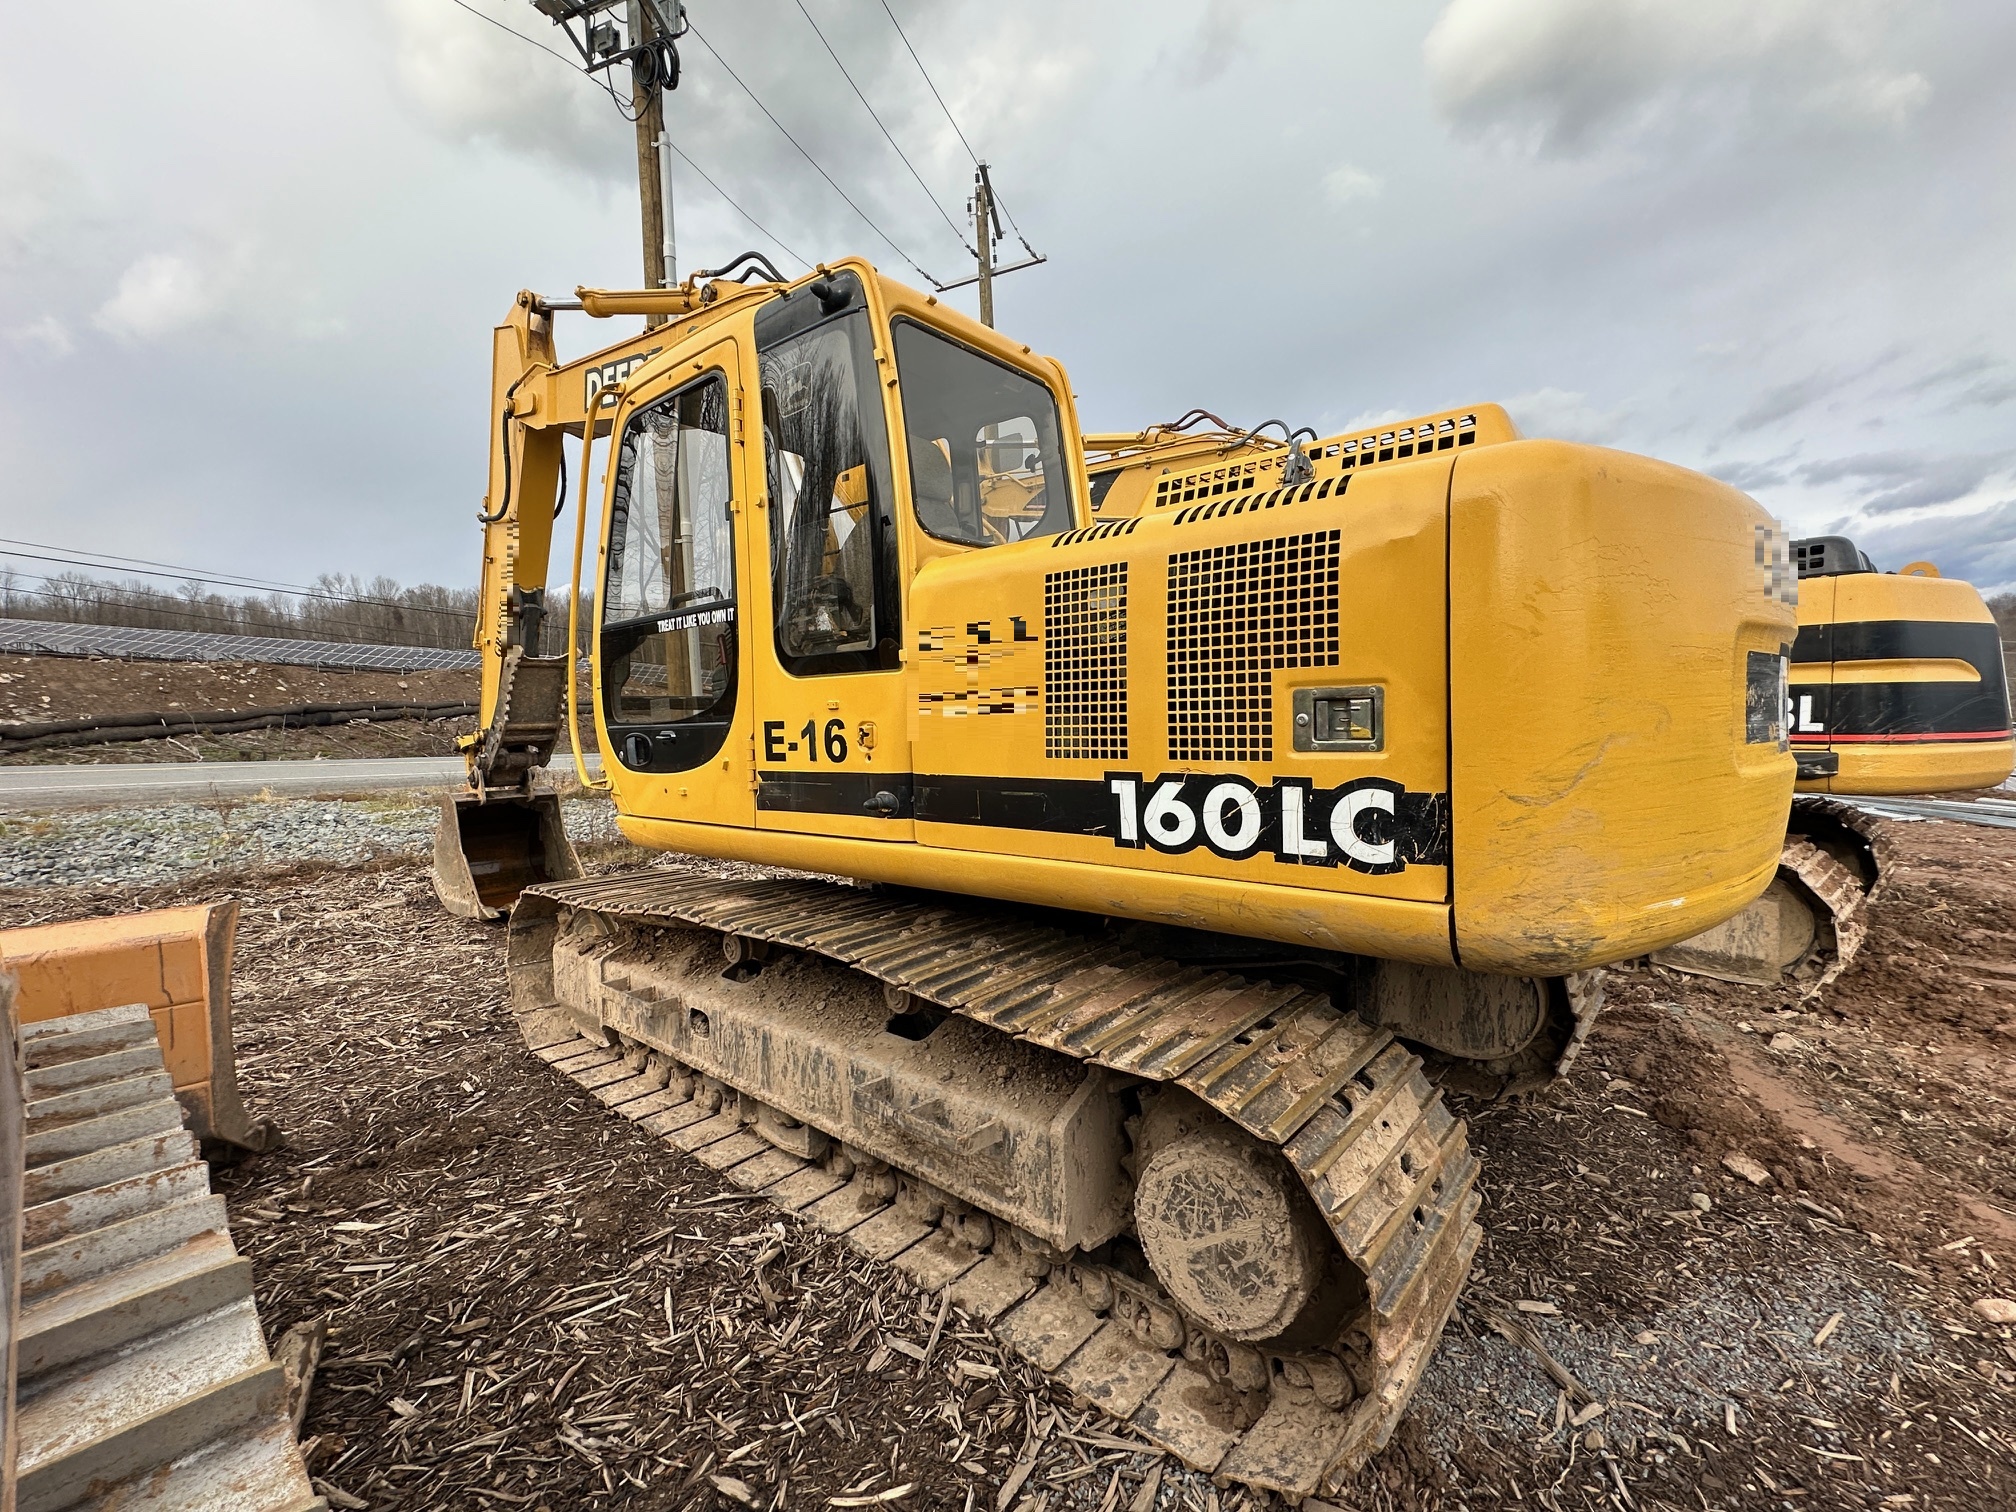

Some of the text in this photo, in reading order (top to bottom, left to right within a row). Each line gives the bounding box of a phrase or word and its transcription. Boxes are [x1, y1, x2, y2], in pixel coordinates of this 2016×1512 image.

[657, 607, 735, 633] TREAT IT LIKE YOU OWN IT
[763, 718, 848, 763] E-16
[1111, 779, 1395, 864] 160 LC
